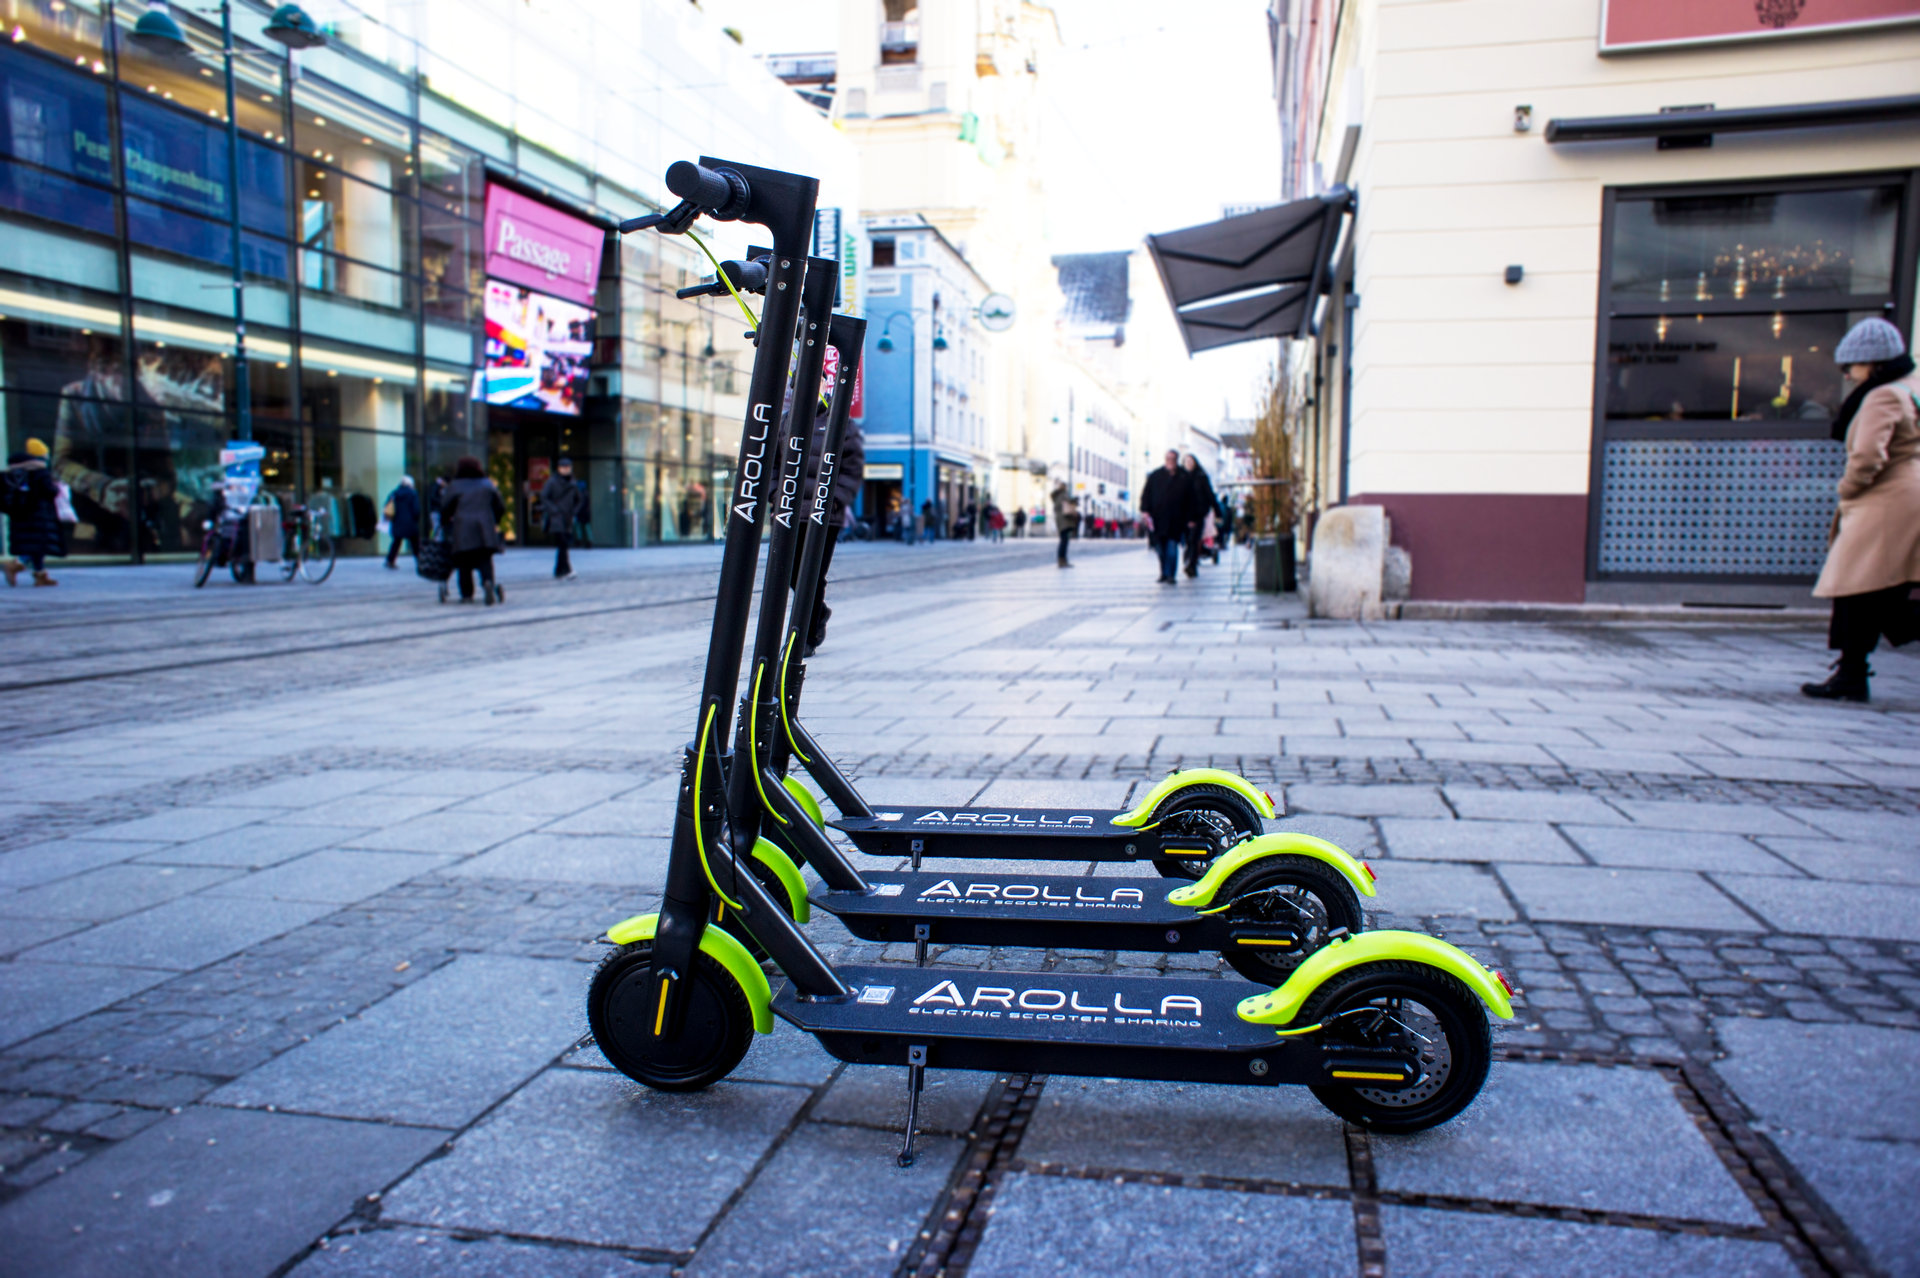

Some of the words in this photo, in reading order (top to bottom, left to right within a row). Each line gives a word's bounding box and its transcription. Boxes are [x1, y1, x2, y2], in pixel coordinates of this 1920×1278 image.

[497, 218, 572, 280] Passage
[817, 209, 836, 260] ATURN
[733, 403, 772, 524] AROLLA
[775, 436, 804, 529] AROLLA
[810, 452, 836, 525] AROLLA
[915, 810, 1094, 825] AROLLA
[916, 897, 989, 905] ELECTRIC
[994, 899, 1070, 907] SCOOTER
[1075, 901, 1142, 909] SHARING
[920, 879, 1144, 902] AROLLA
[908, 1006, 1002, 1018] ELECTRIC
[1009, 1011, 1107, 1023] SCOOTER
[1114, 1016, 1202, 1028] SHARING
[913, 979, 1202, 1016] AROLLA
